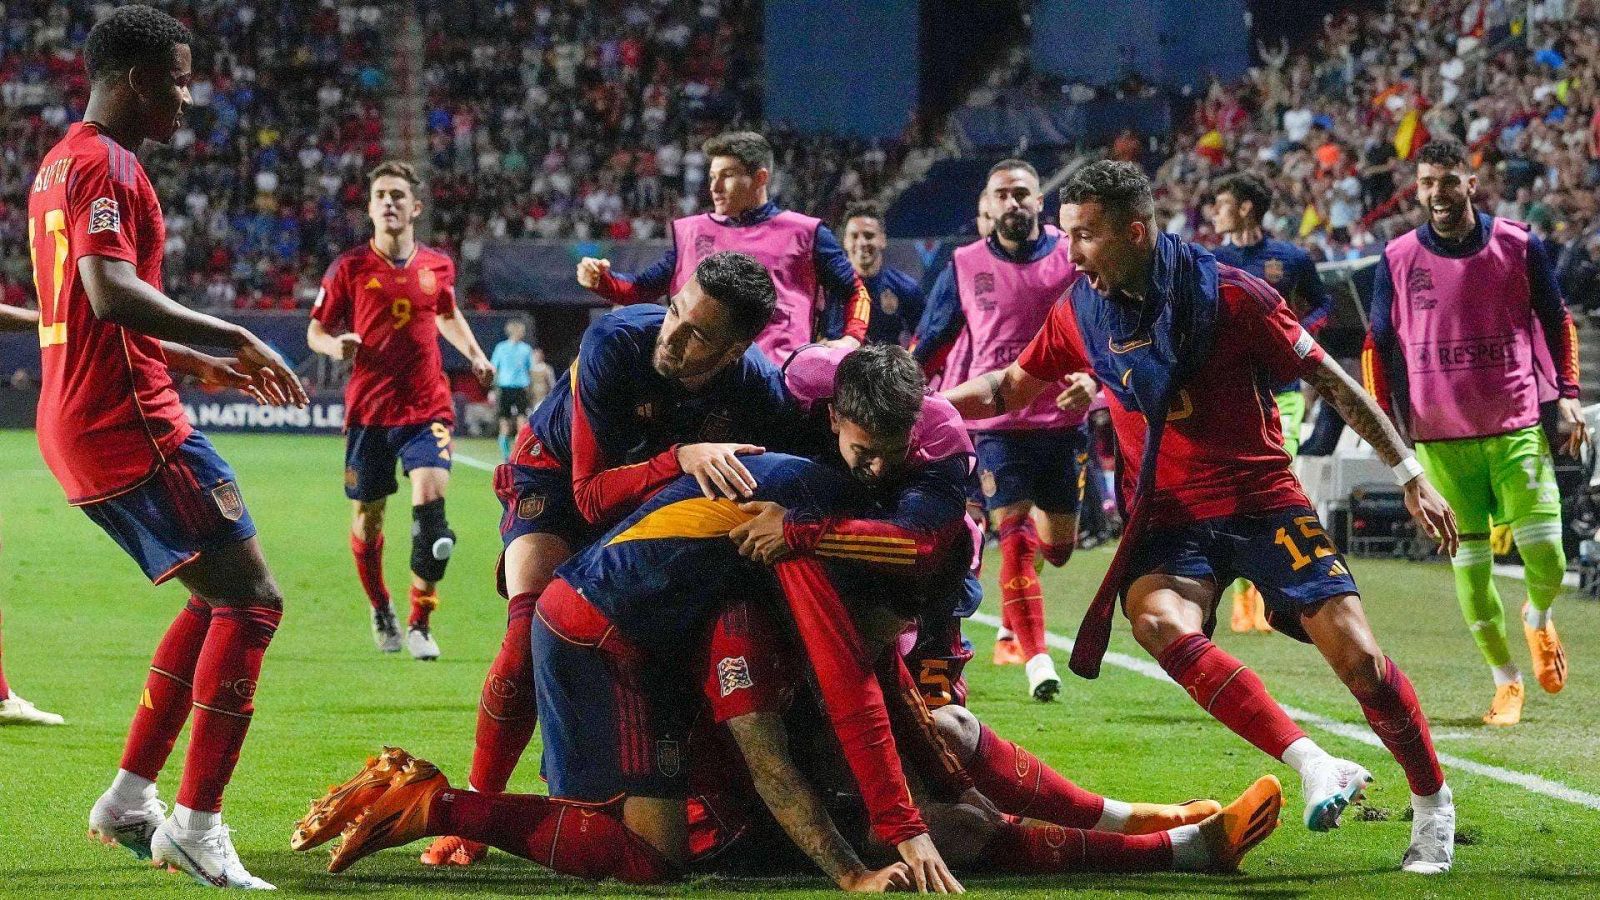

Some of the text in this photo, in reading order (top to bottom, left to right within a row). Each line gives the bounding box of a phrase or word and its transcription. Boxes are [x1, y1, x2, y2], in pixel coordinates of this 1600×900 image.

[391, 298, 412, 330] 9
[200, 403, 311, 428] NATIONS
[430, 422, 451, 449] 9
[1274, 515, 1337, 572] 15
